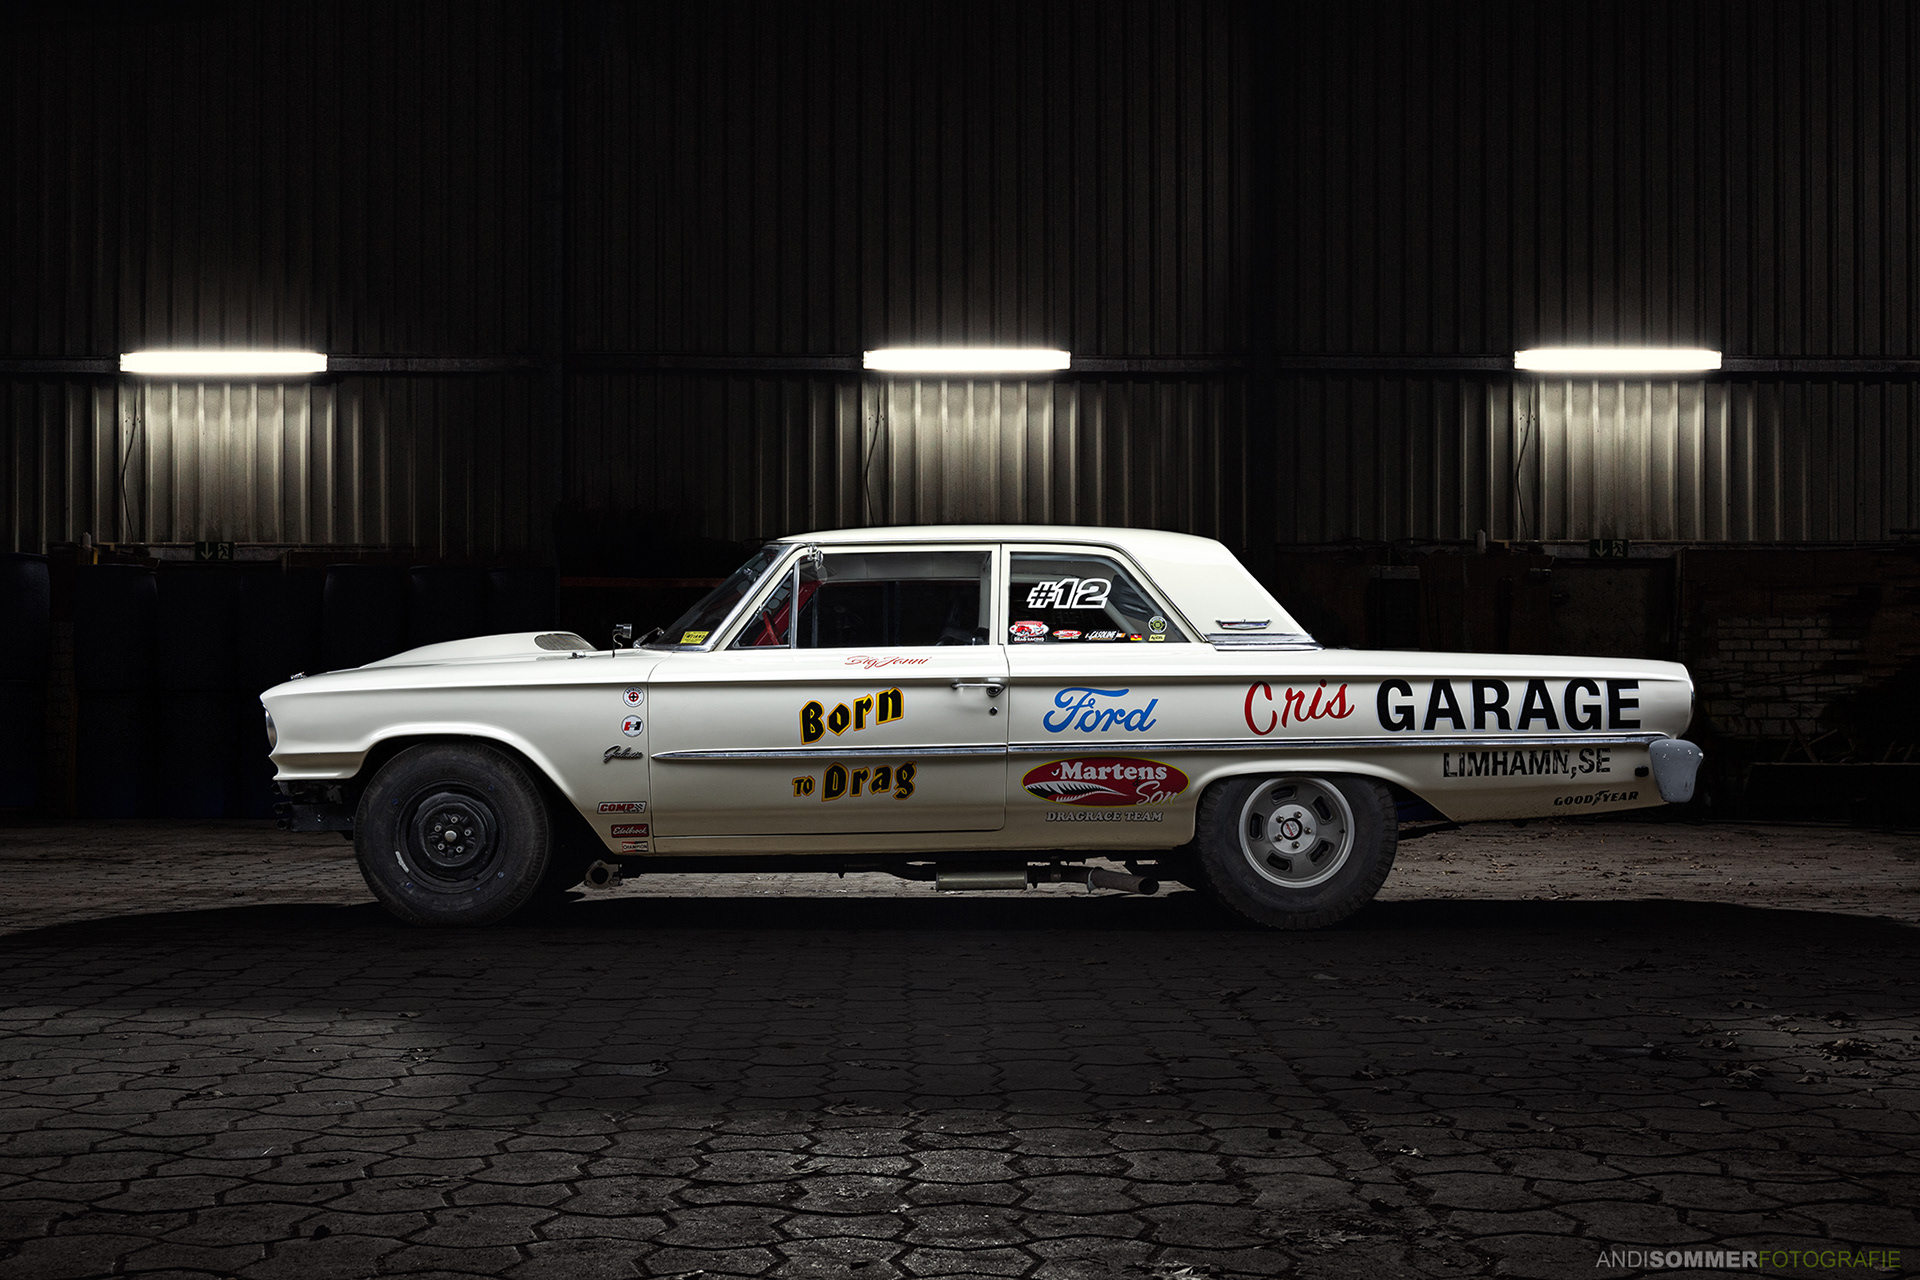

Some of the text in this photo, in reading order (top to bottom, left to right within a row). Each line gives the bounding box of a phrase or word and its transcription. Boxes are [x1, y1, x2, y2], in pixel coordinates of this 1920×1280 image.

[1027, 578, 1112, 609] #12
[799, 686, 904, 745] Born
[1043, 687, 1159, 733] Ford
[1244, 678, 1641, 736] Cris GARAGE
[822, 761, 917, 802] Drag
[1060, 762, 1168, 780] Martens
[600, 803, 635, 812] COMP
[1136, 780, 1178, 806] Son
[1046, 811, 1163, 822] DRAGRACE TEAM
